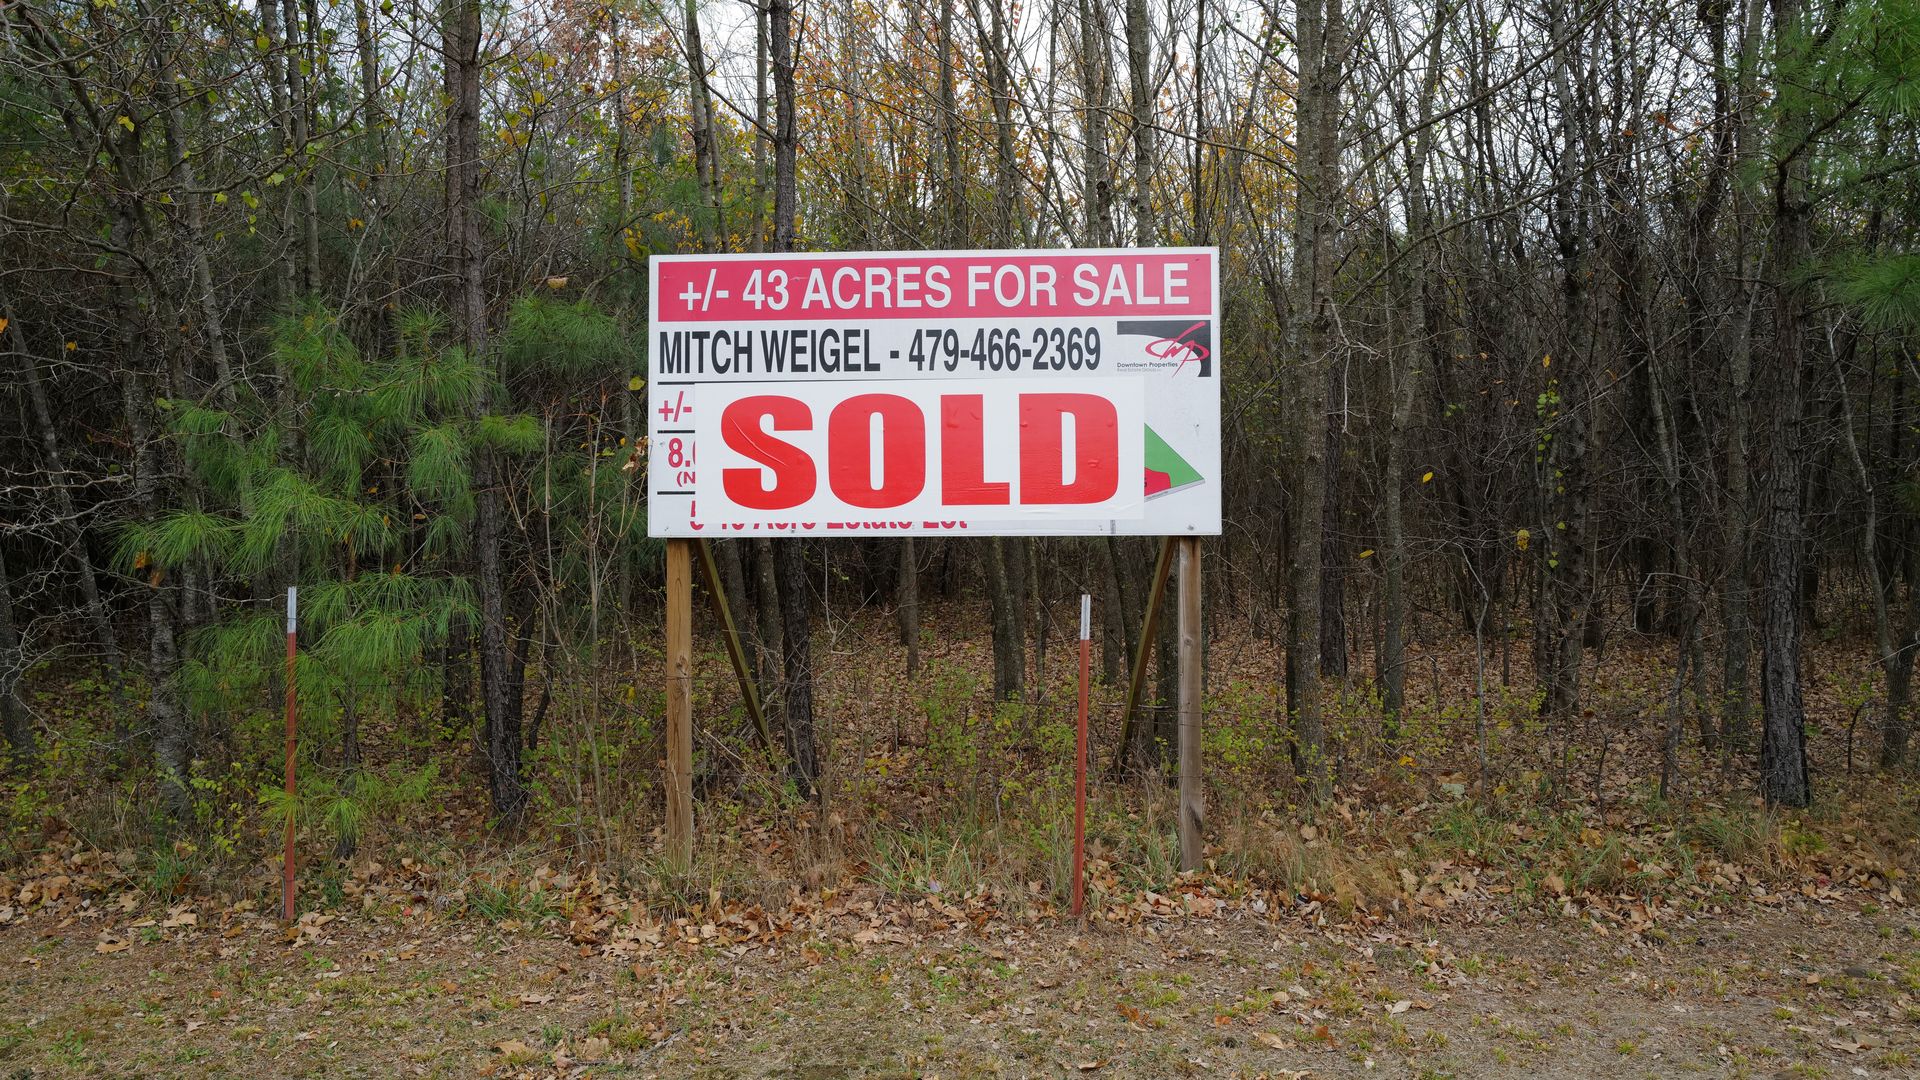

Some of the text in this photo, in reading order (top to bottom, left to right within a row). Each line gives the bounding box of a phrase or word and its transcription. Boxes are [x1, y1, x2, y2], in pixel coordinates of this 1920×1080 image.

[679, 263, 1190, 312] +/- 43 ACRES FOR SALE
[659, 329, 753, 375] MITCH
[760, 328, 881, 374] WEIGEL
[908, 326, 1101, 372] 479-466-2369
[720, 392, 1119, 510] SOLD
